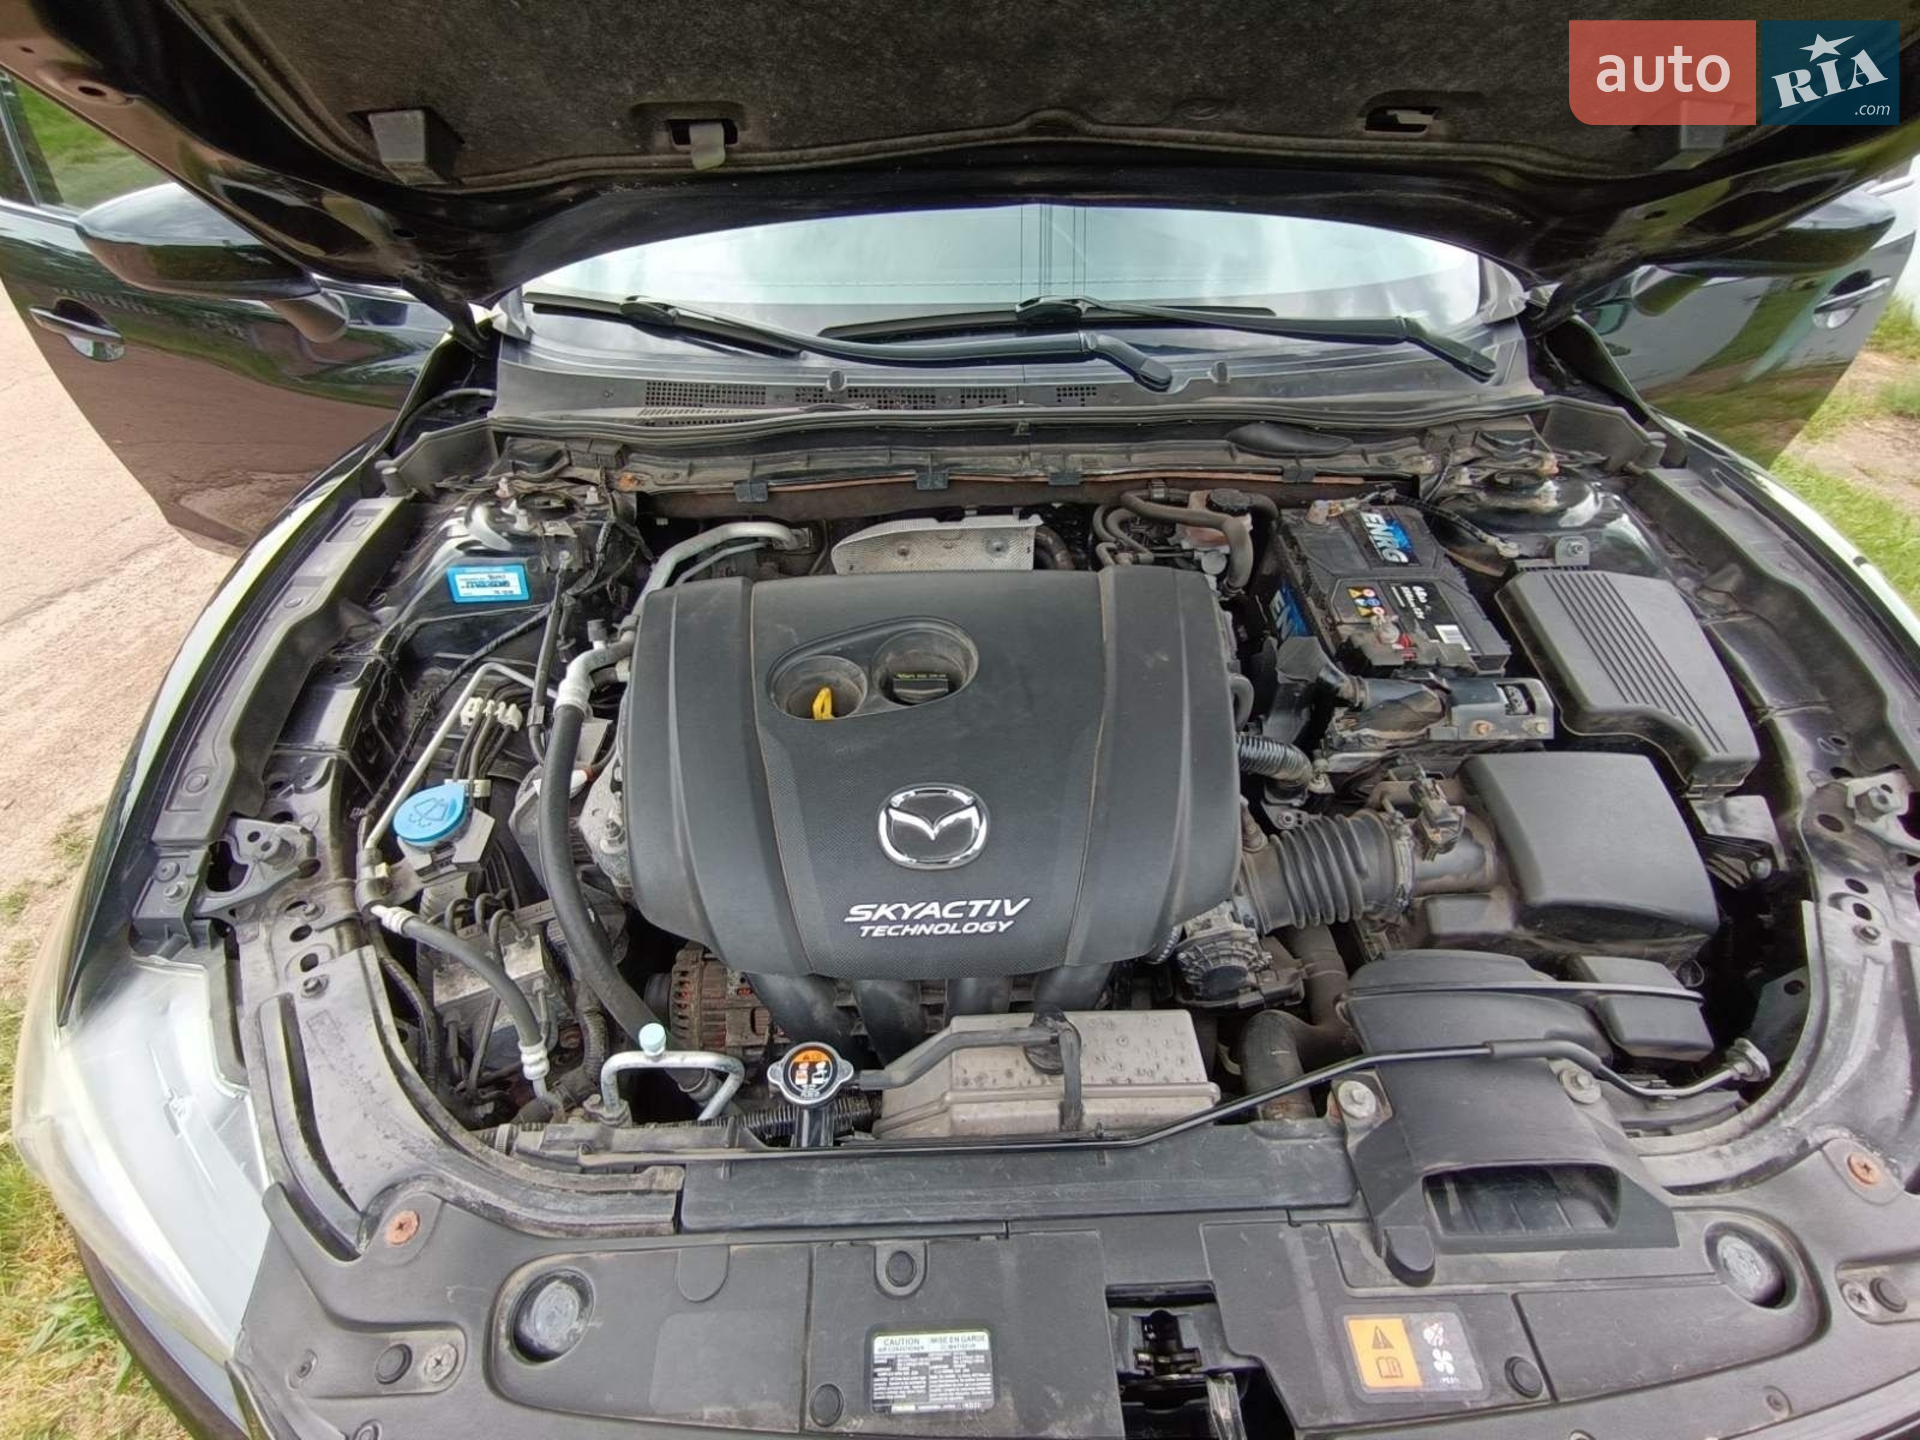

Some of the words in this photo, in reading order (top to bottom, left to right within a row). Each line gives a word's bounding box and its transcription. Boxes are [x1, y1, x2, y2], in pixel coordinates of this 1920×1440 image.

[1360, 511, 1409, 564] ENRG
[844, 898, 1031, 922] SKYACTIV
[860, 920, 1014, 937] TECHNOLOGY
[883, 1337, 920, 1346] CAUTION
